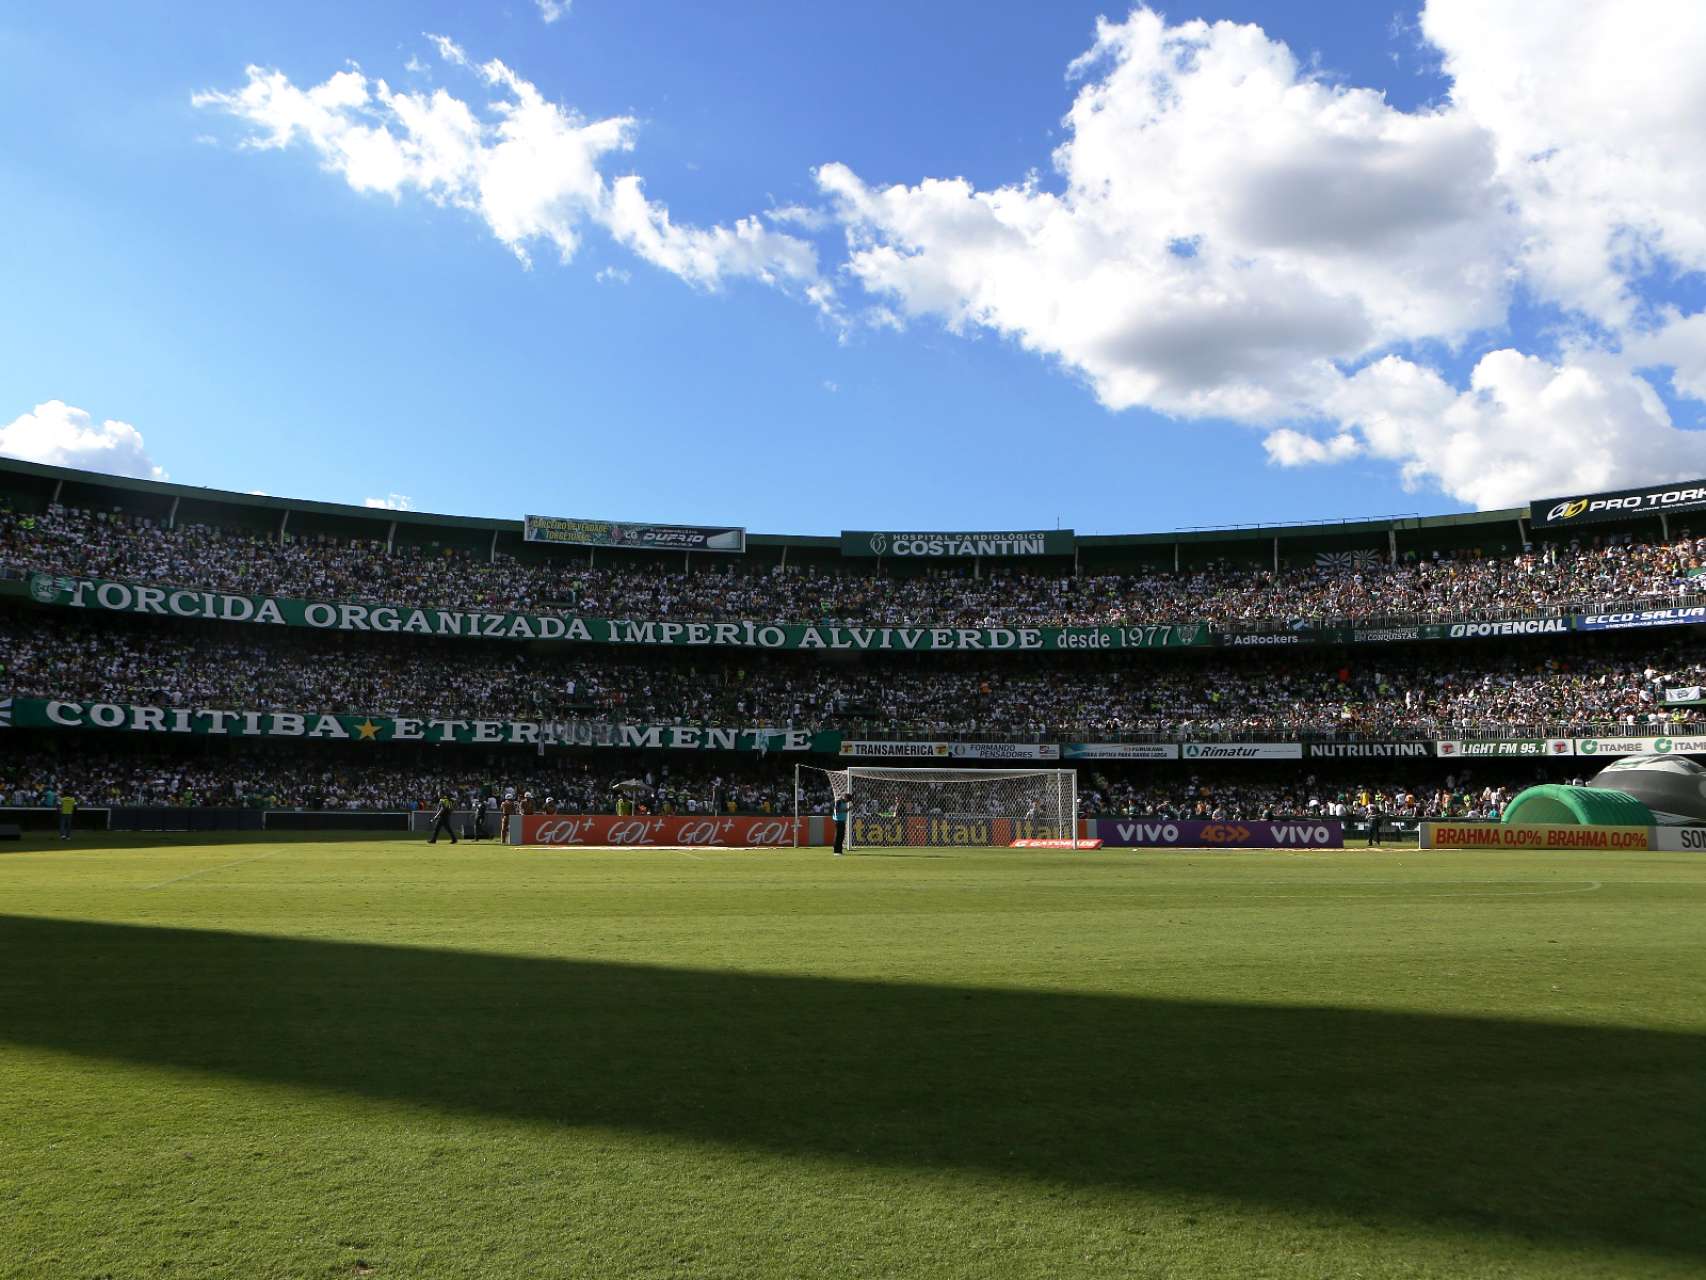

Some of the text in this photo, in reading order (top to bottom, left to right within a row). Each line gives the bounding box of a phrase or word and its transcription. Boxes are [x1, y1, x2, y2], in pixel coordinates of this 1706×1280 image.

[1589, 497, 1642, 511] PRO
[893, 532, 1045, 541] HOSPITAL CARDIOLÓGICO
[893, 539, 1045, 556] COSTANTINI
[70, 577, 287, 625] TORCIDA
[305, 602, 592, 640] ORGANIZADA
[799, 625, 1044, 650] ALVIVERDE
[1057, 628, 1111, 648] desde
[1119, 626, 1172, 648] 1977
[1466, 619, 1567, 636] POTENCIAL
[1234, 633, 1299, 646] AdRockers
[46, 700, 350, 738] CORITIBA
[391, 717, 813, 751] ETERMENTE
[968, 744, 1016, 752] FORMANDO
[1200, 746, 1260, 757] Rimatur
[1311, 743, 1428, 757] NUTRILATINA
[1461, 743, 1496, 754] LIGHT
[1498, 743, 1517, 754] FM
[1519, 743, 1547, 754] 95.1
[1116, 823, 1179, 842] VIVO
[1270, 825, 1330, 843] VIVO
[1435, 828, 1648, 848] BRAHMA 0,0% BRAHMA 0,0%
[1030, 839, 1097, 848] GATOADE
